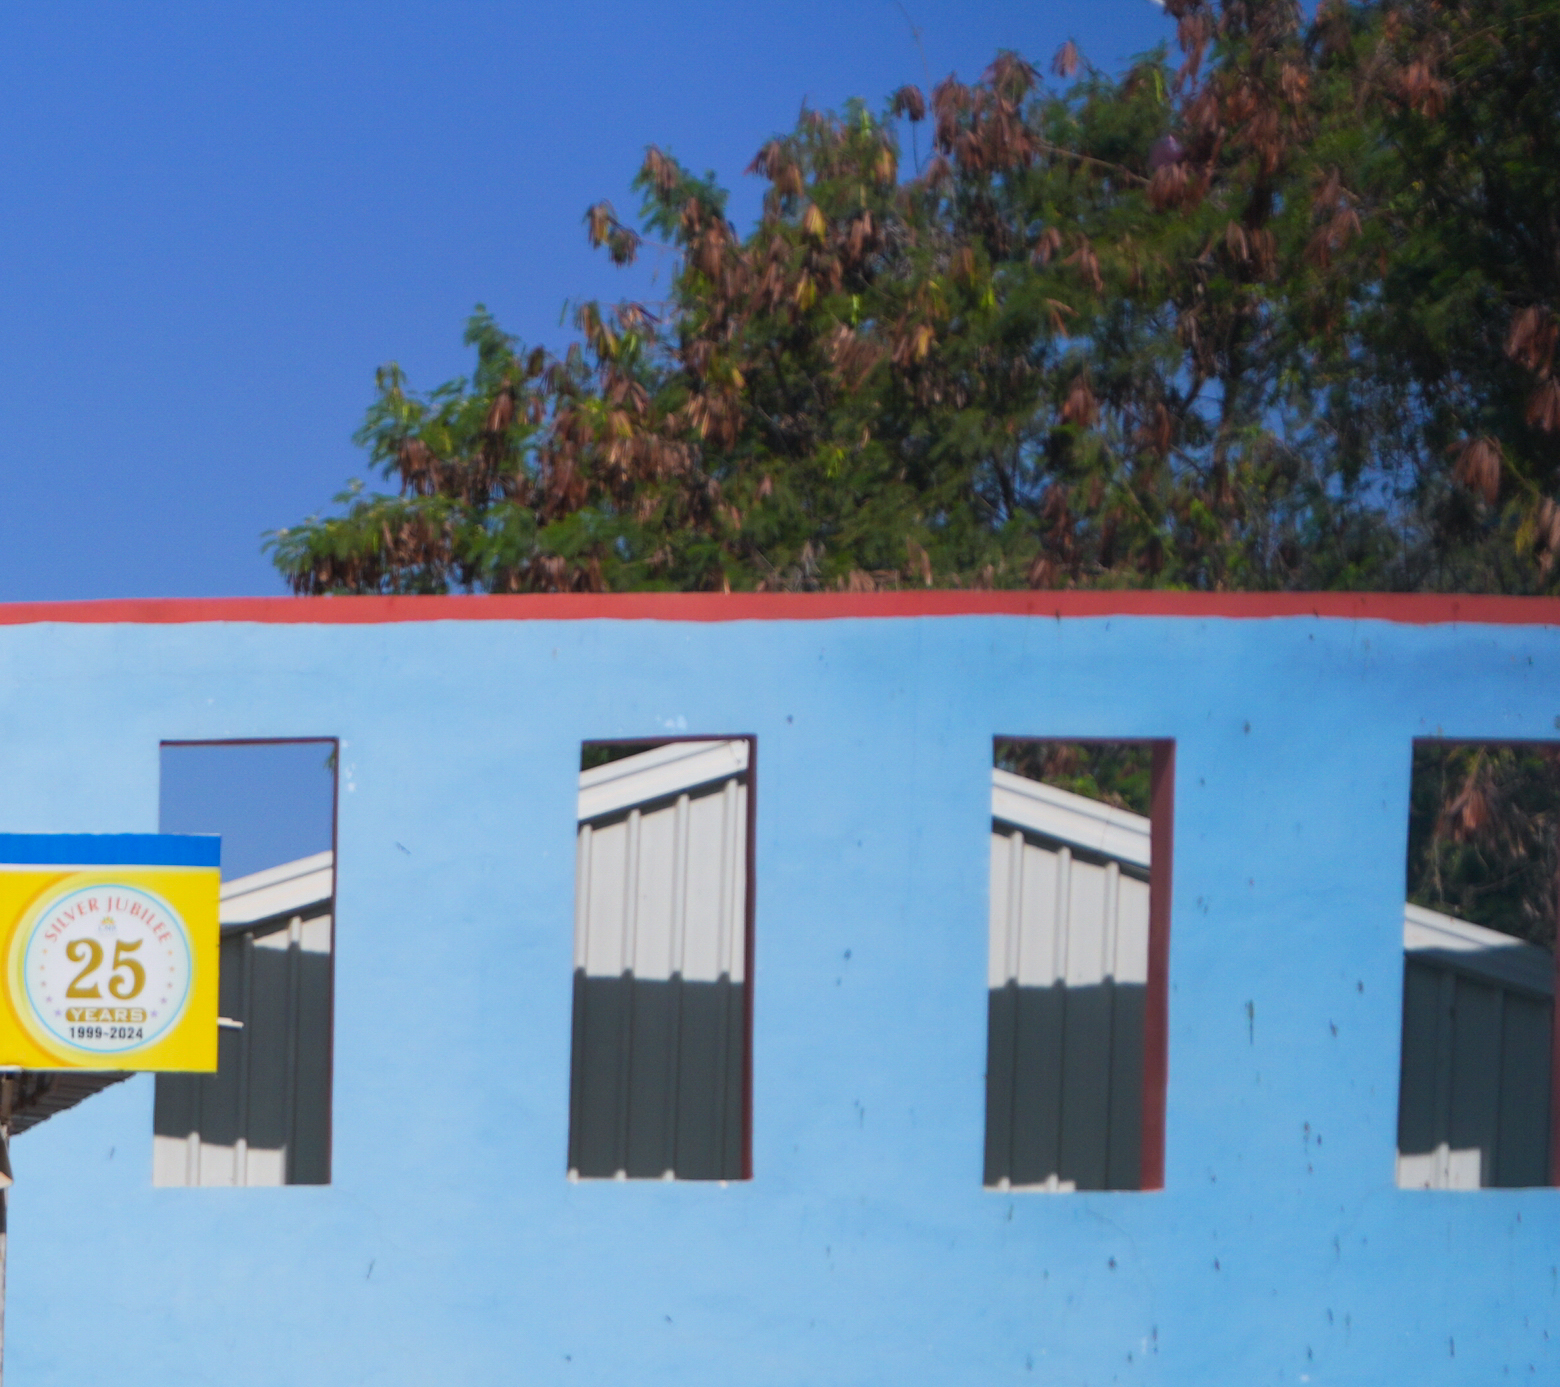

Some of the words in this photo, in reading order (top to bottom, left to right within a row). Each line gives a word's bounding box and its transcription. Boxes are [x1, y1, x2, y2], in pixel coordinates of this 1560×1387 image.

[44, 897, 100, 942] SILVER
[106, 896, 173, 943] JUBILEE
[65, 938, 146, 1000] 25
[71, 1008, 144, 1022] YEARS
[70, 1026, 144, 1040] 1999-2024
